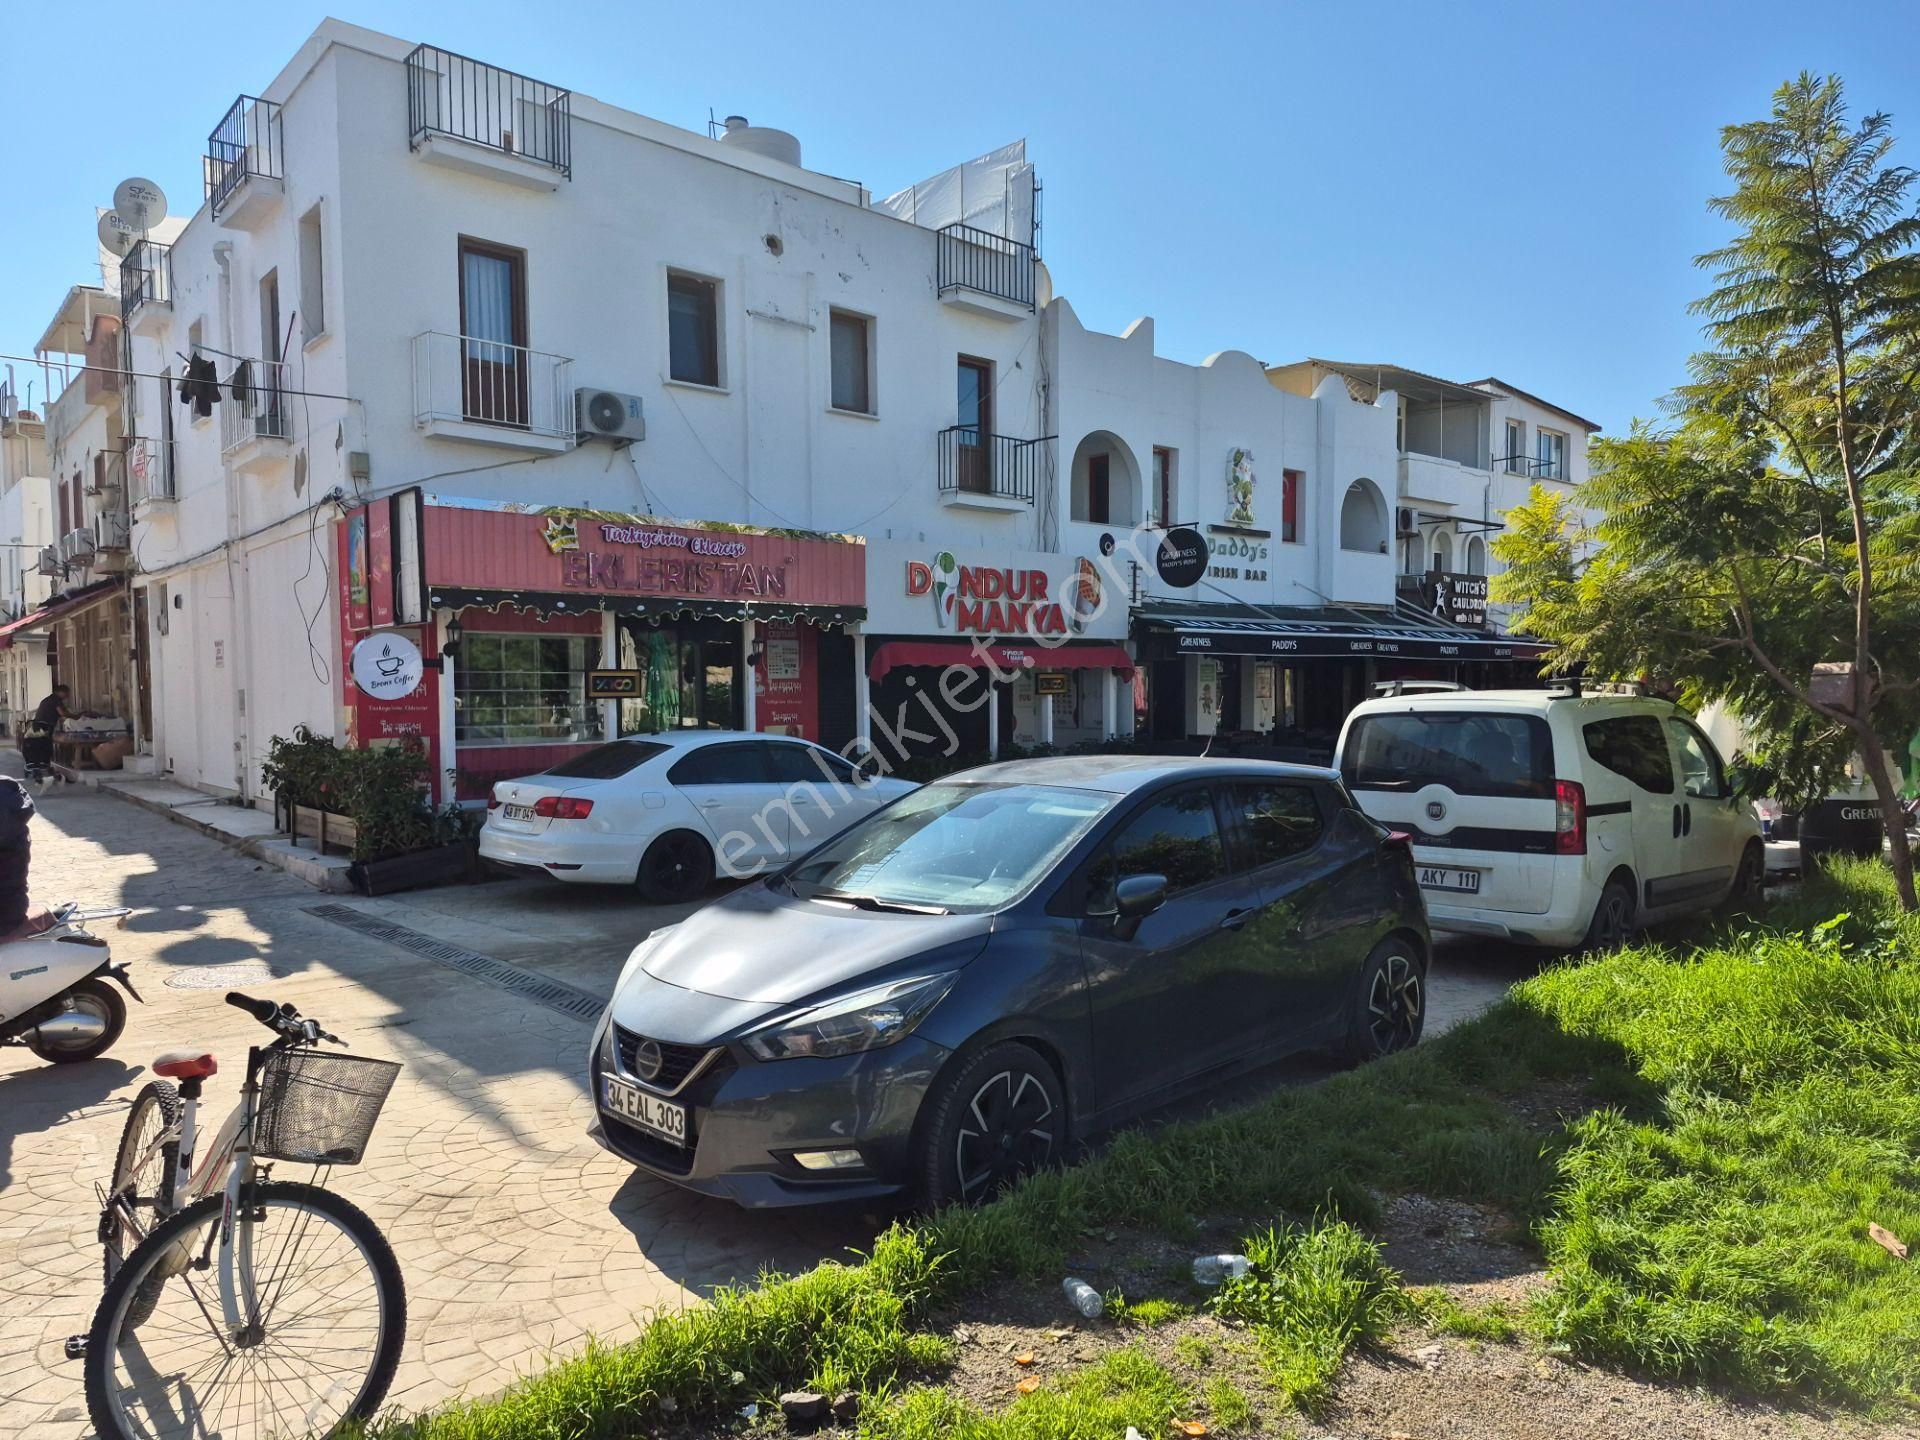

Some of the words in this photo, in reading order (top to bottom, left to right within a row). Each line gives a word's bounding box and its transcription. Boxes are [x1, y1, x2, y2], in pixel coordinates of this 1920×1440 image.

[601, 524, 688, 548] Türkiye'nin
[1207, 537, 1268, 562] Paddy's
[1208, 566, 1238, 580] IRISH
[1244, 569, 1267, 581] BAR
[1455, 581, 1486, 595] WITCH'S
[1452, 597, 1487, 610] CAULDRON
[957, 601, 1067, 633] MANYA
[1180, 636, 1211, 647] GREATNESS
[1272, 640, 1297, 650] PADDYS
[394, 674, 414, 686] Coffee
[1421, 869, 1447, 885] AKY
[1458, 872, 1476, 888] 111
[609, 1083, 623, 1112] 34
[627, 1090, 654, 1125] EAL
[656, 1102, 684, 1136] 303
